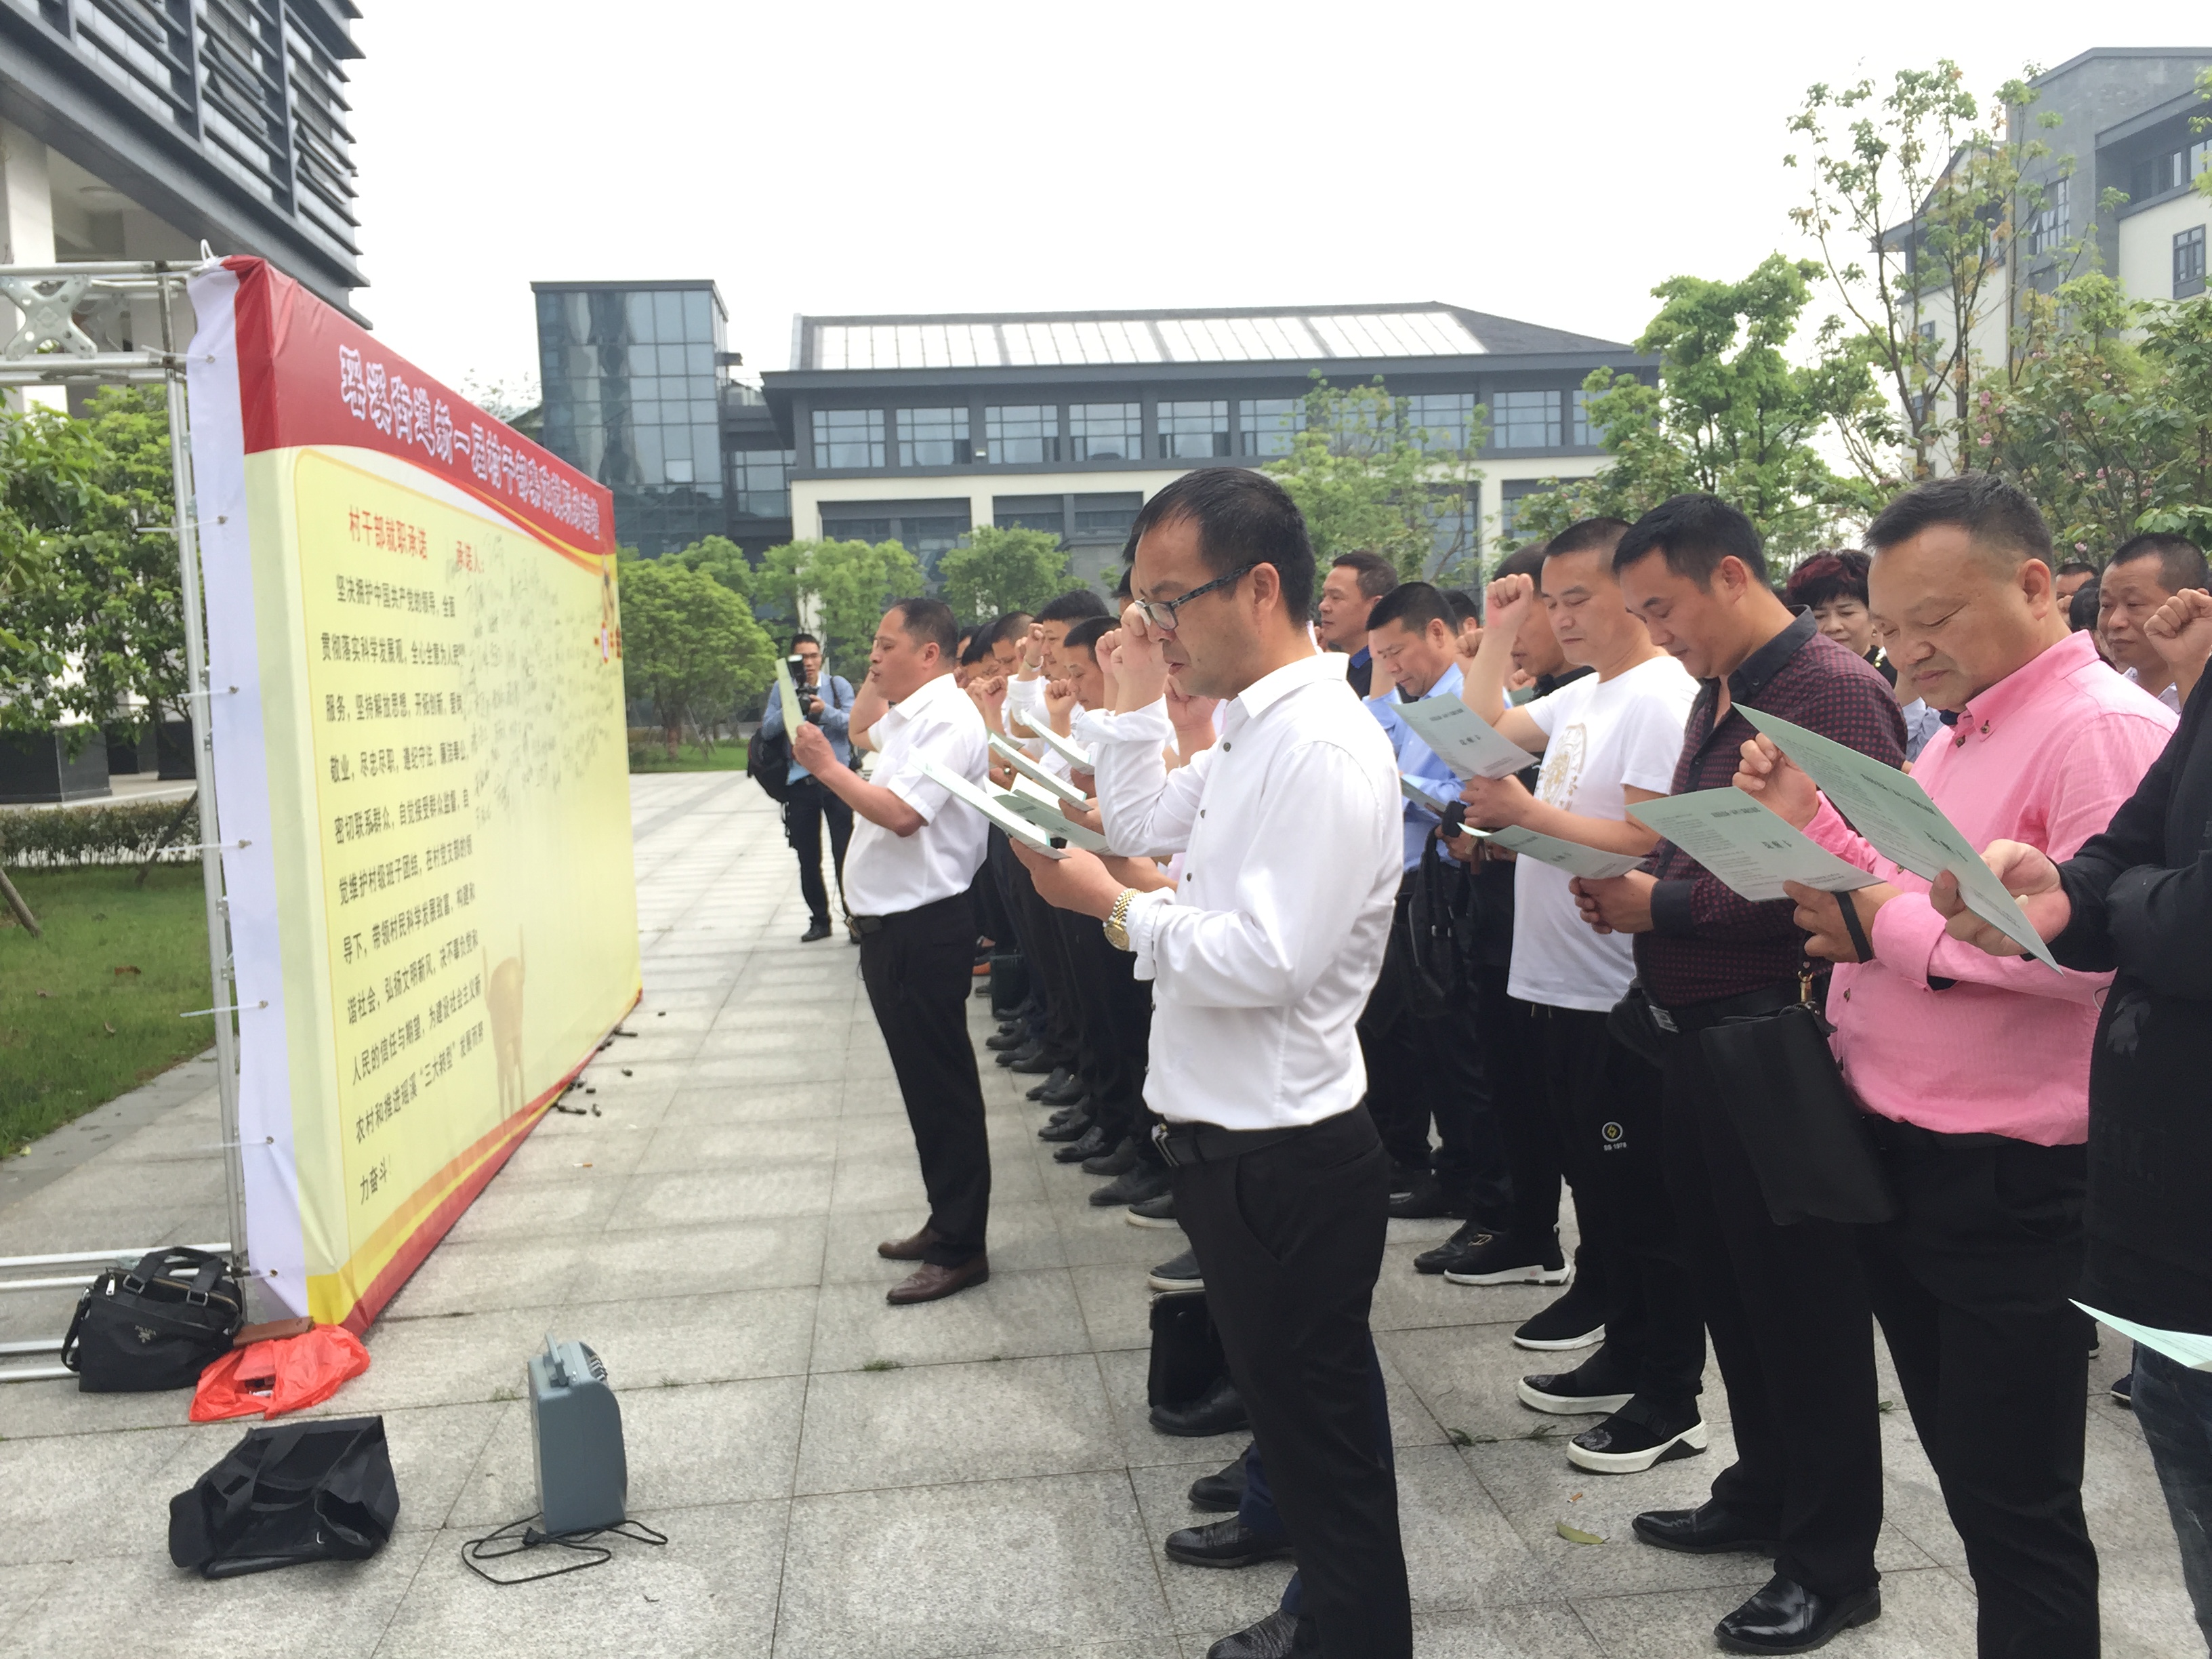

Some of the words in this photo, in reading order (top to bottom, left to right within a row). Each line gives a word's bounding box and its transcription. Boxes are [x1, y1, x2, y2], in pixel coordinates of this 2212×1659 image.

[348, 506, 428, 560] 村干部就职承诺
